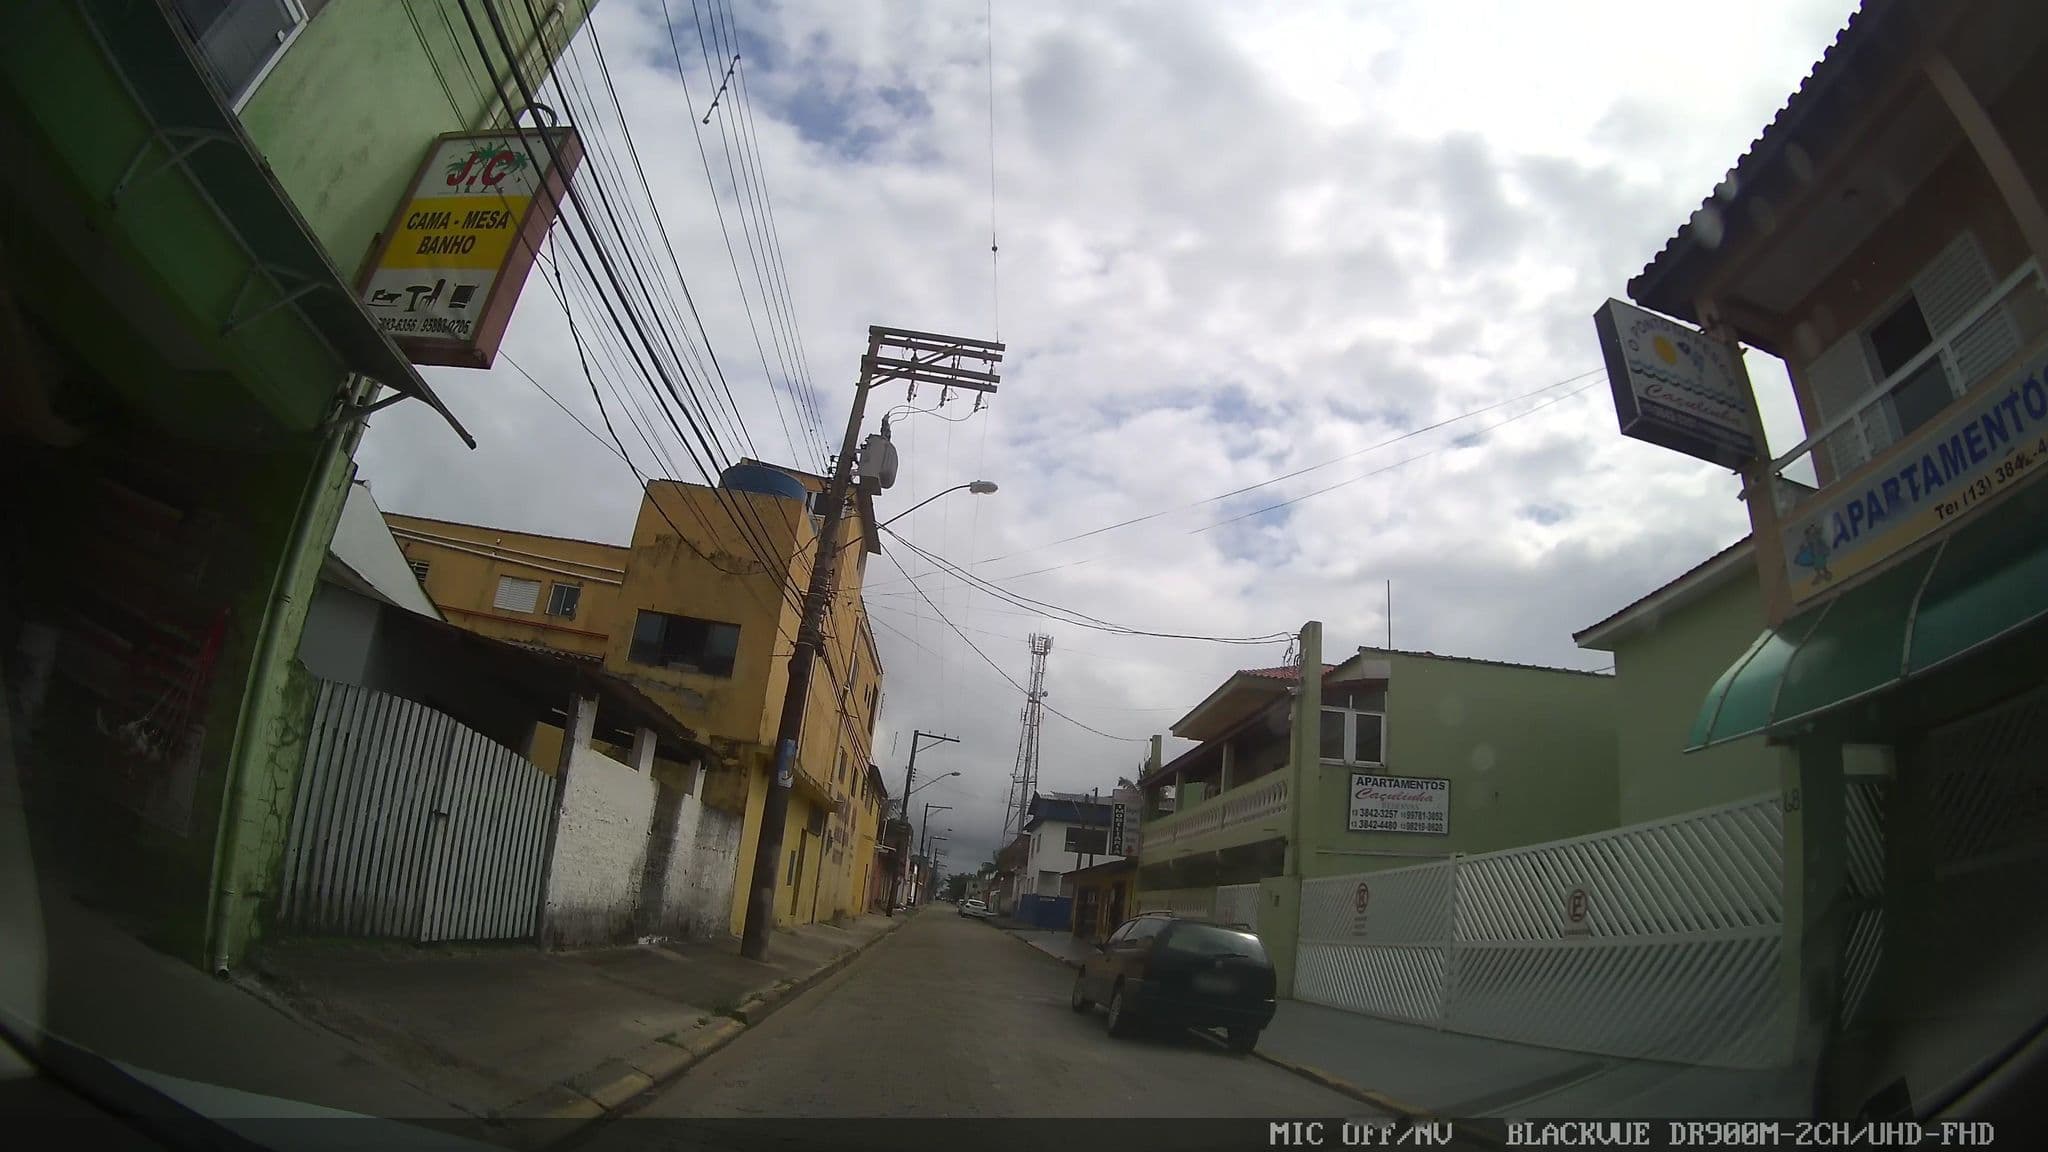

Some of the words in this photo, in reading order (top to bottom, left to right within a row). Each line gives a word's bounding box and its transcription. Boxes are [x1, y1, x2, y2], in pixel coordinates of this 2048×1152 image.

[407, 211, 449, 230] CAMA
[462, 209, 511, 229] MESA
[416, 235, 476, 254] BANHO
[1832, 363, 2048, 549] APARTAMENTO
[1356, 776, 1446, 790] APARTAMENTOS
